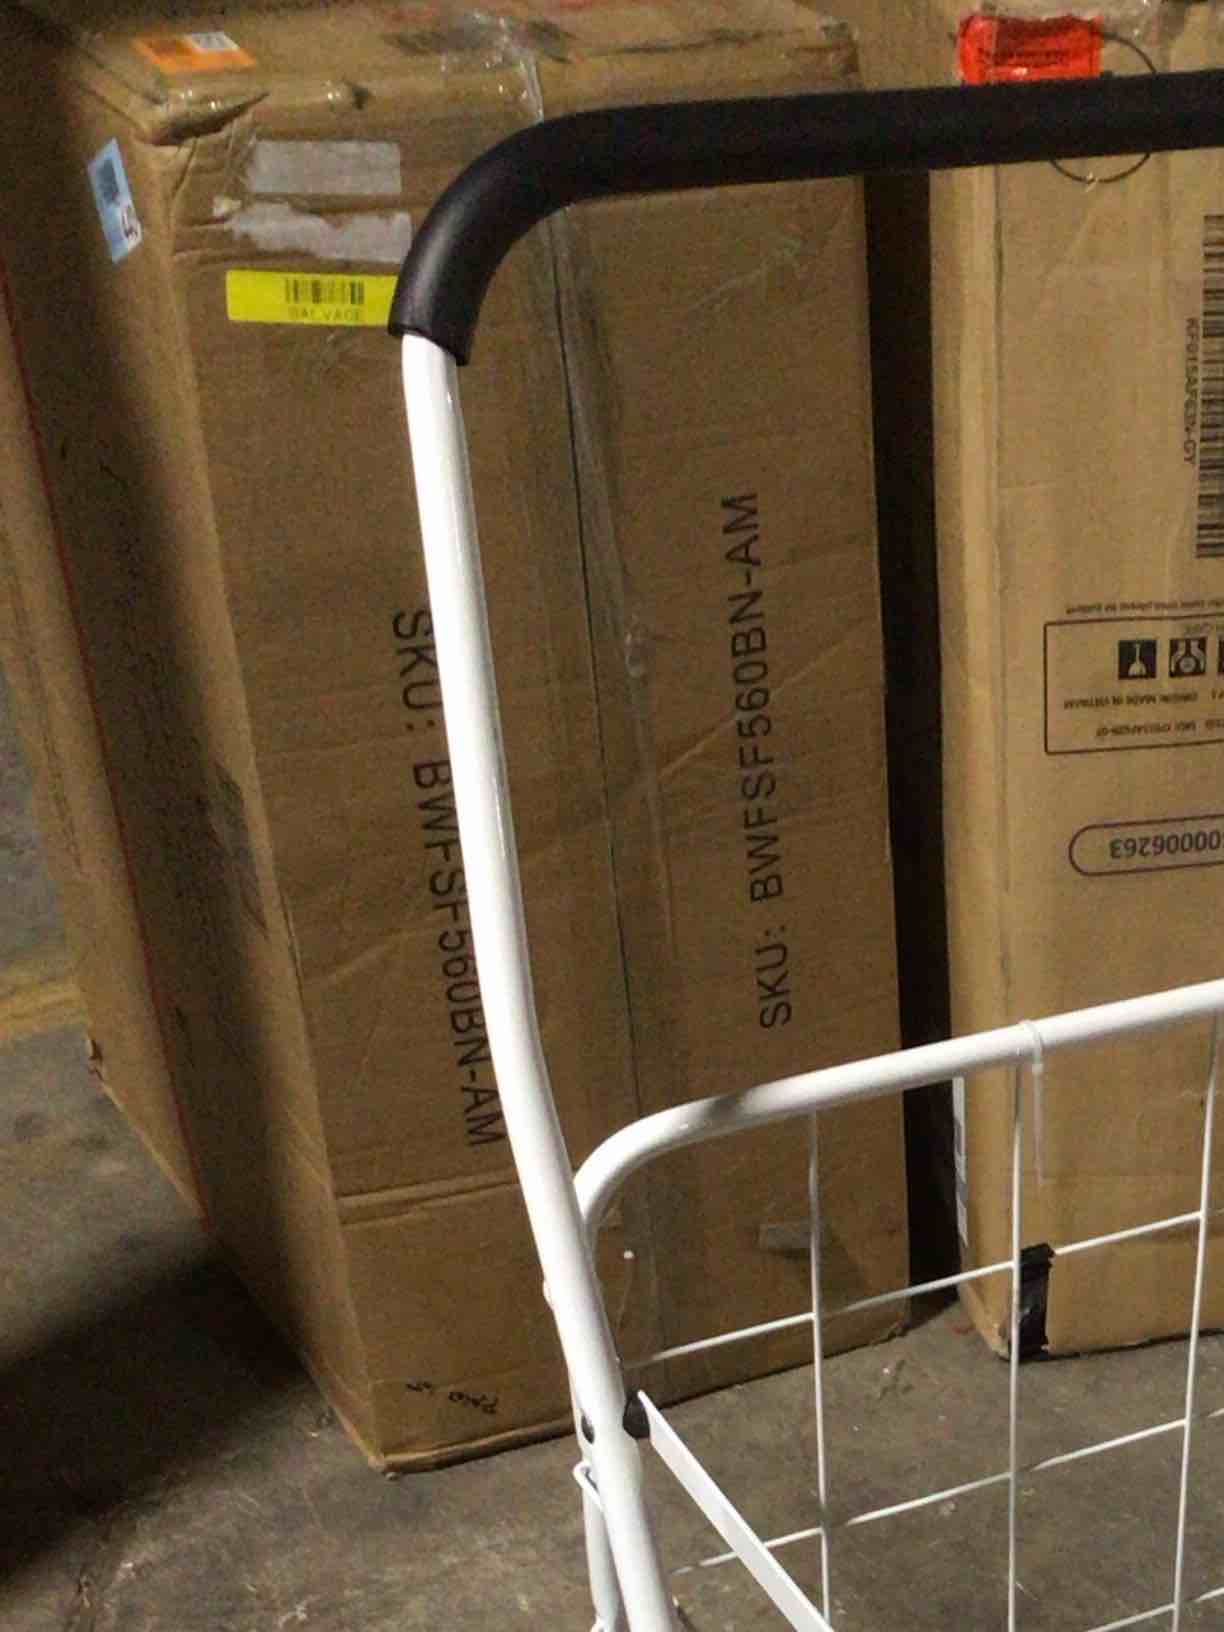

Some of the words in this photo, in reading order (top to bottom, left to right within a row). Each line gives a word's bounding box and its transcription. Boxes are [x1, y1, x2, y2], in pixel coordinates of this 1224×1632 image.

[391, 608, 443, 733] SKU:
[720, 492, 784, 904] BWFSF560BN-AM
[755, 924, 793, 1030] SKU:
